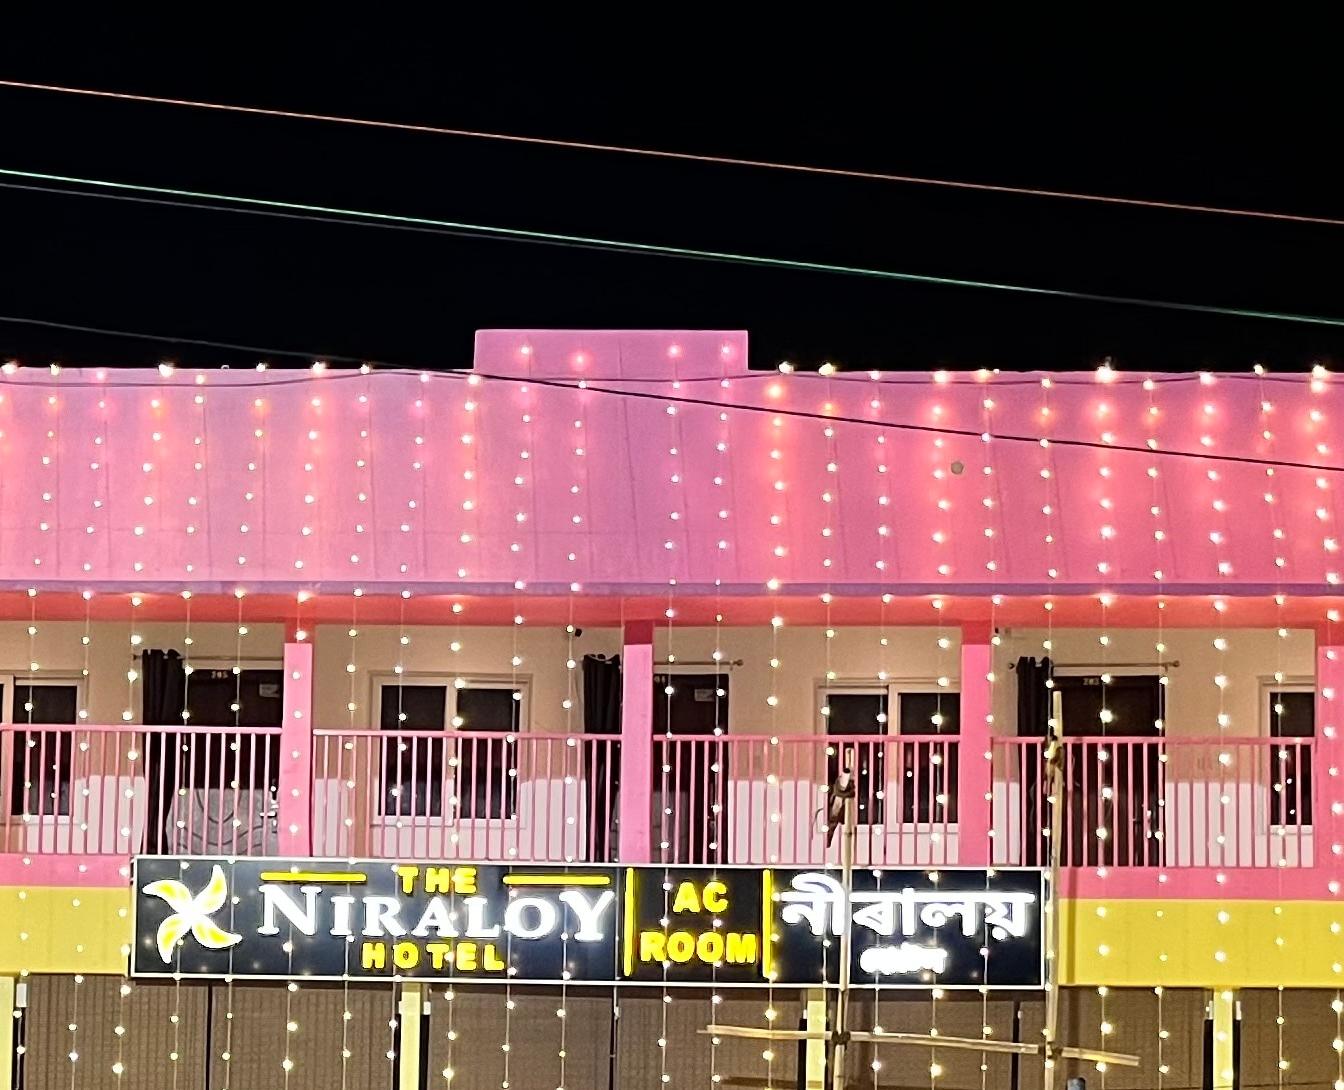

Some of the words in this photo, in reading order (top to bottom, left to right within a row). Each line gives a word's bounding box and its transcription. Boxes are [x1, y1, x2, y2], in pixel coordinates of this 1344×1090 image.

[397, 867, 477, 894] THE
[257, 884, 615, 942] NIRALOY
[672, 881, 729, 914] AC
[361, 942, 505, 972] HOTEL
[639, 931, 757, 964] ROOM
